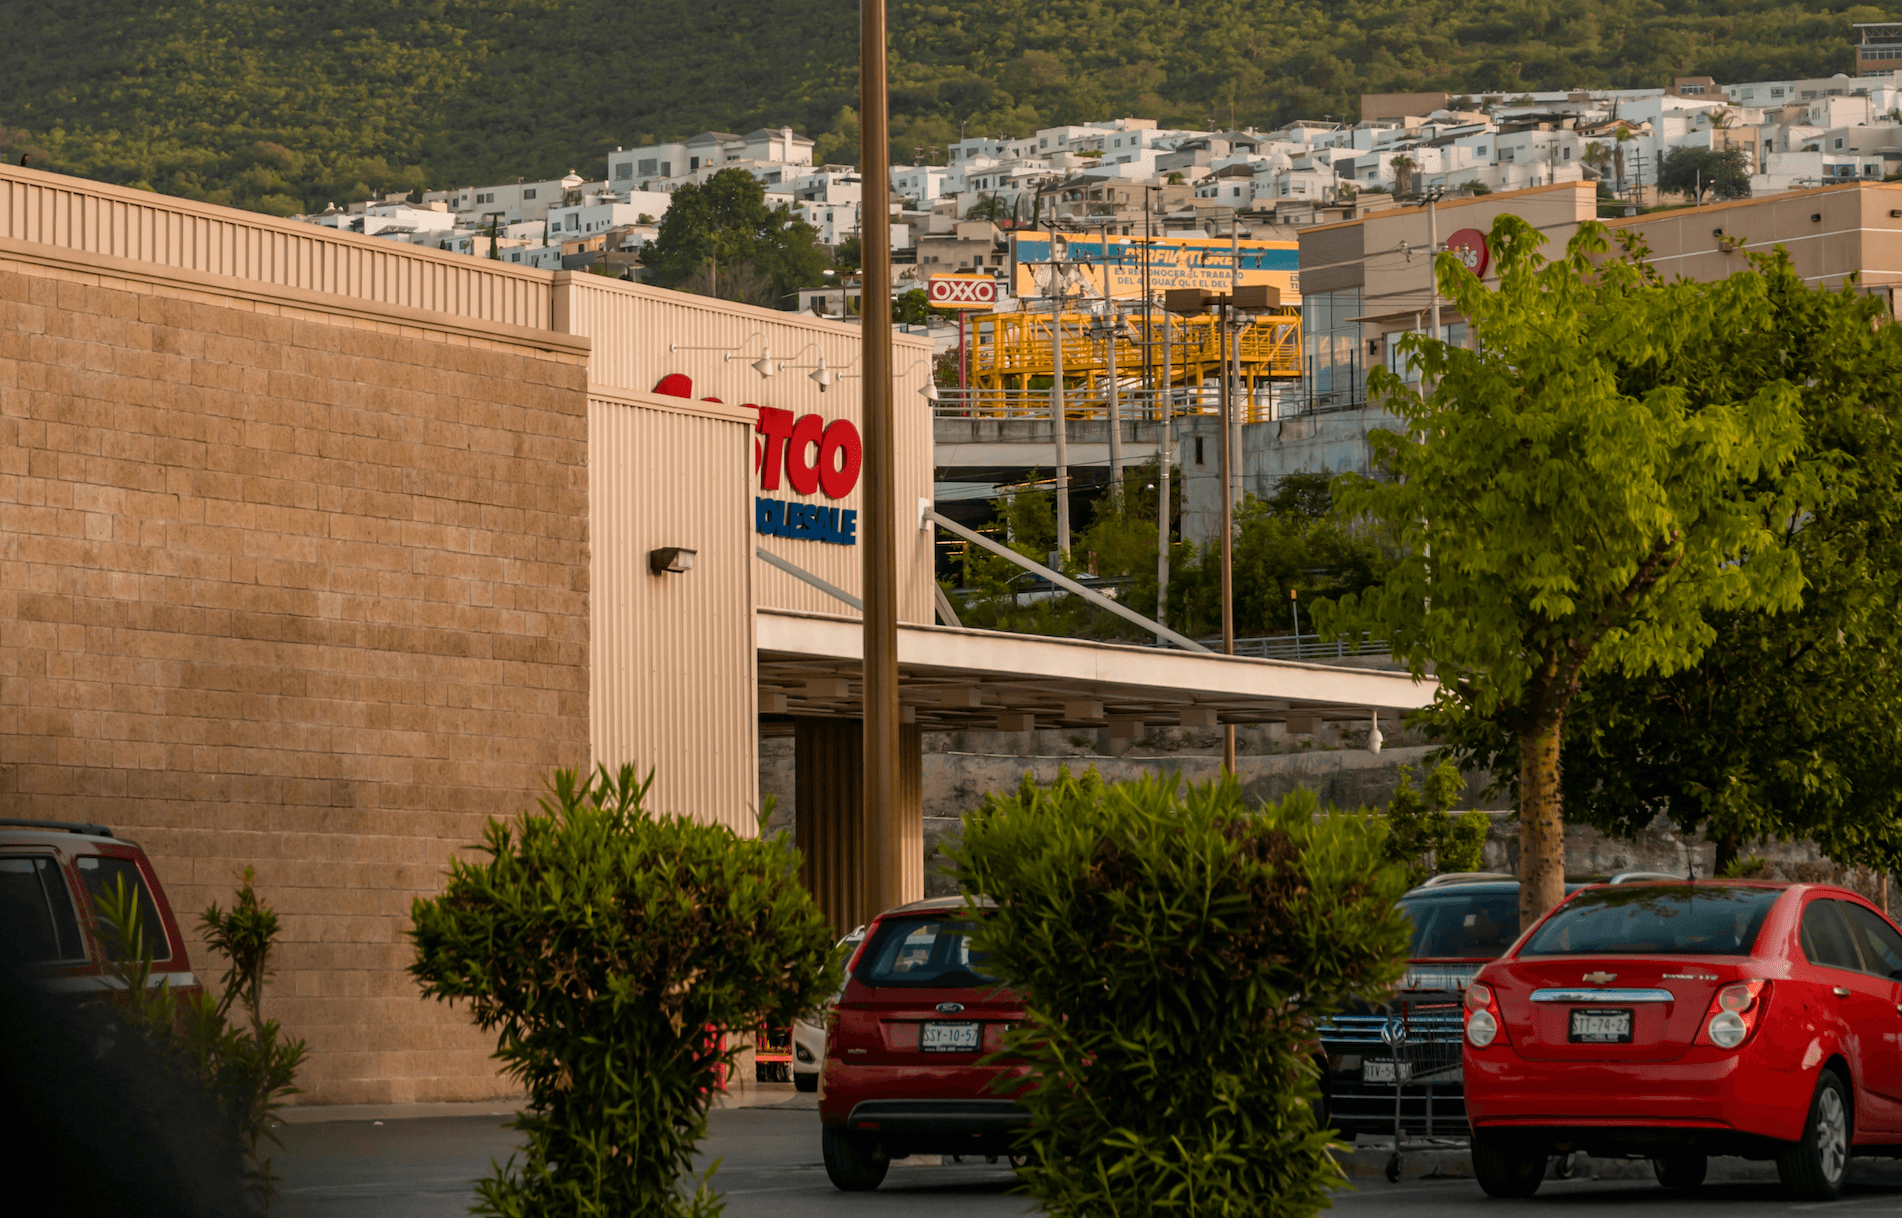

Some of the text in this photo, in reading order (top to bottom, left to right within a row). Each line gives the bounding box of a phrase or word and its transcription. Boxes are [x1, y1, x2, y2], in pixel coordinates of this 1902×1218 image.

[1114, 267, 1126, 275] ES
[1201, 271, 1244, 279] TRABAO
[1117, 277, 1135, 285] DEL
[1211, 280, 1228, 288] DEL
[933, 280, 993, 302] OXXO
[924, 1028, 978, 1042] SSY-10-57
